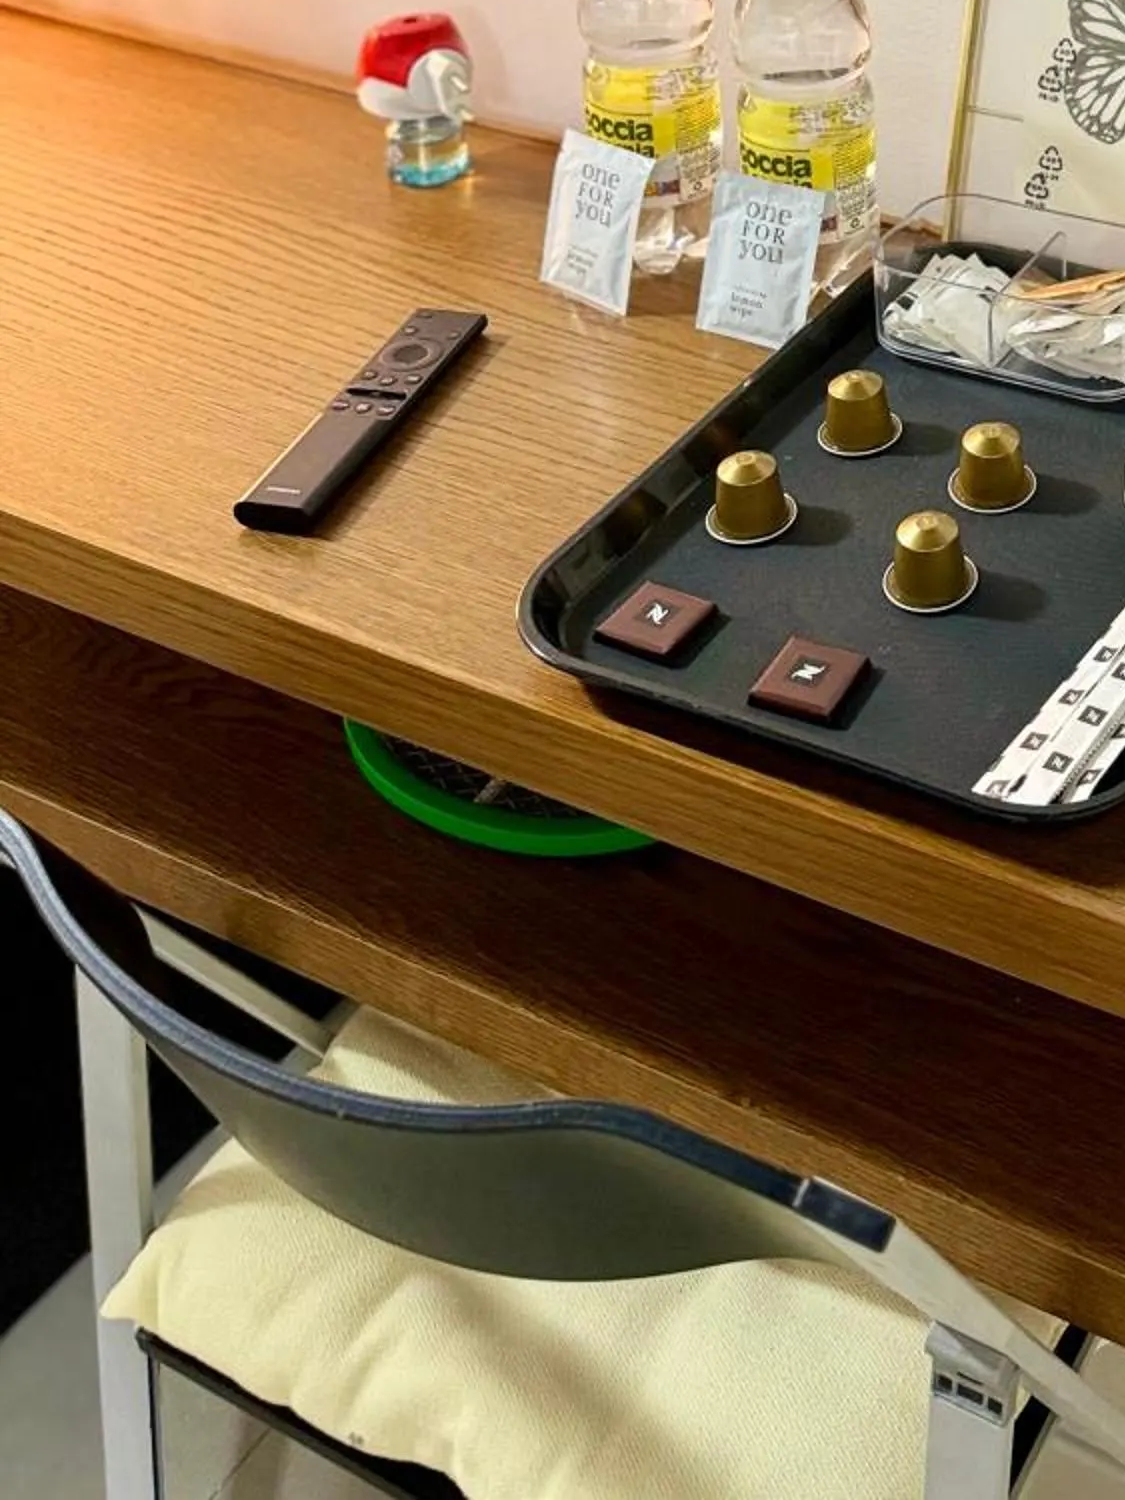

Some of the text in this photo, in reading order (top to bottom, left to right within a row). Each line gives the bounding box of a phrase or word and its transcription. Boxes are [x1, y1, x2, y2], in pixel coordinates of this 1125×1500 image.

[582, 163, 620, 190] one
[579, 181, 613, 209] FOR
[575, 199, 611, 228] you
[746, 201, 793, 226] one
[742, 219, 785, 245] FOR
[739, 240, 783, 264] you
